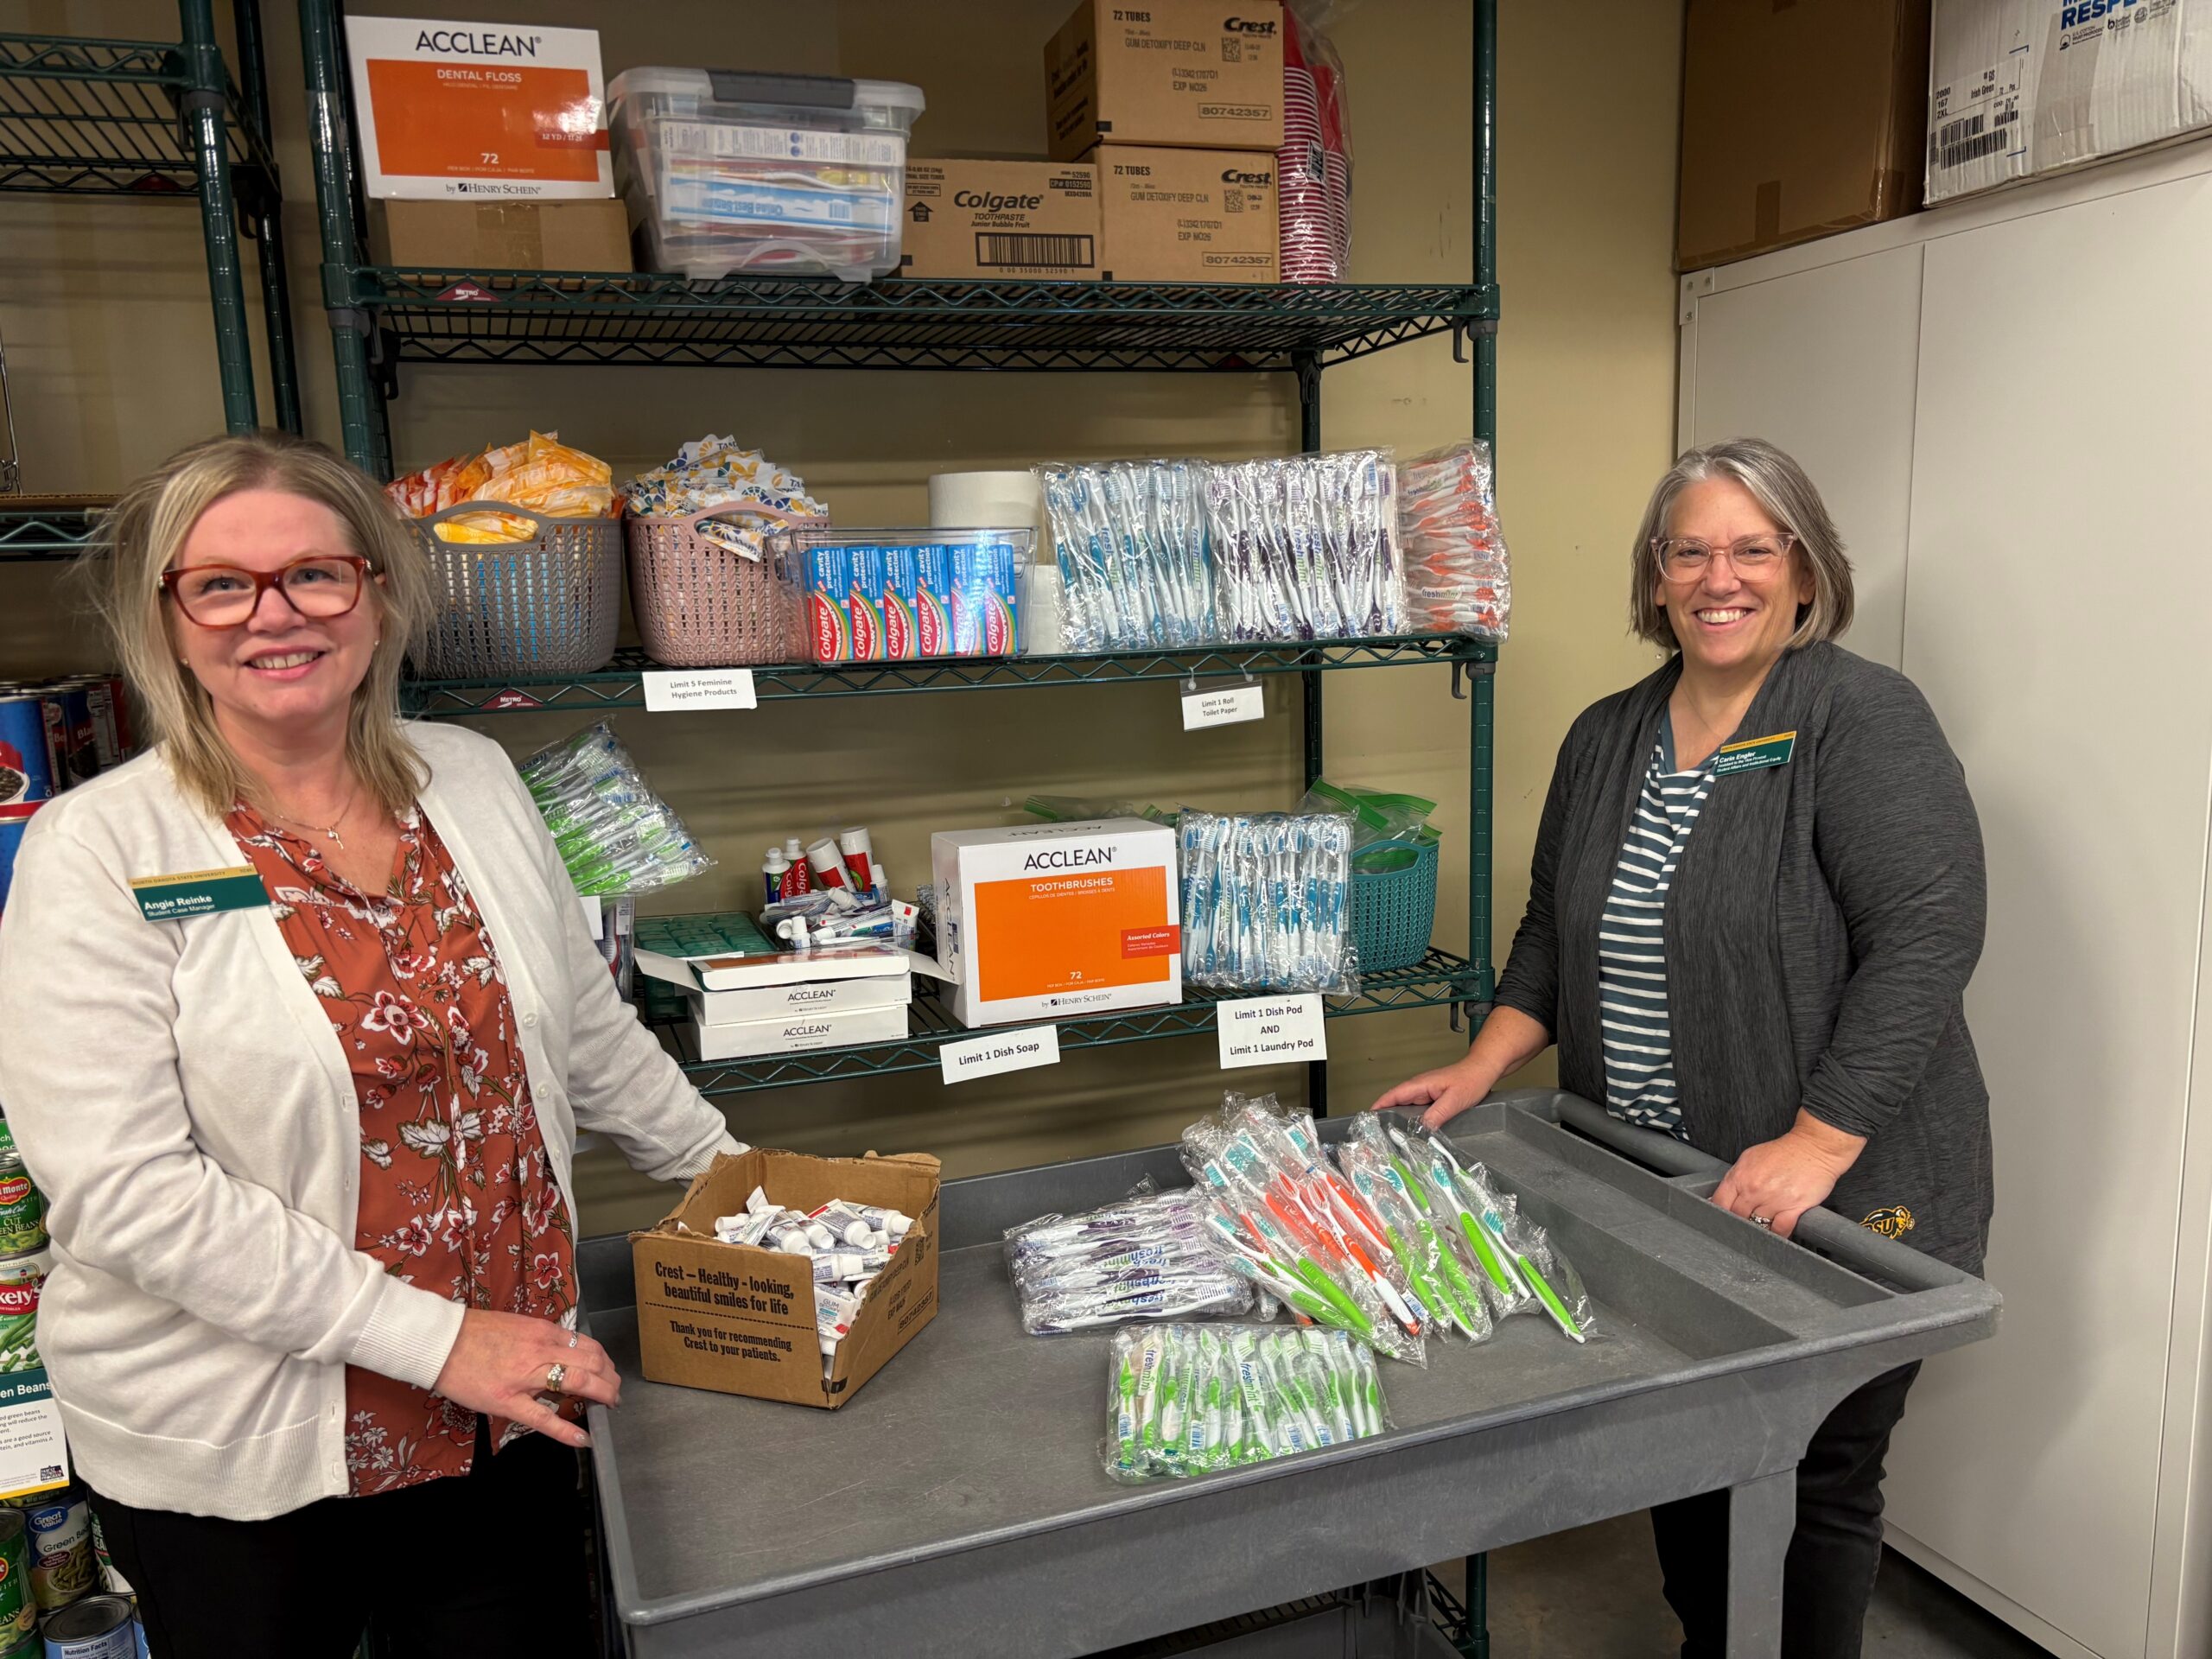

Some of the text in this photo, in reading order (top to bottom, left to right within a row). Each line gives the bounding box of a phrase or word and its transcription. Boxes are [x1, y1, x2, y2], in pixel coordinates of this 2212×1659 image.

[1113, 10, 1151, 22] 72 TUBES
[1224, 17, 1274, 34] Crest
[416, 30, 537, 57] ACCLEAN
[1125, 38, 1140, 48] GUM
[1141, 39, 1173, 49] DETOXIFY
[1174, 41, 1191, 51] DEEP
[437, 69, 522, 83] DENTAL FLOSS
[1173, 81, 1187, 91] EXP
[1982, 84, 1994, 95] Green
[1202, 107, 1269, 118] 80742357
[481, 153, 499, 164] 72
[1114, 165, 1151, 176] 72 TUBES
[1221, 168, 1271, 184] Crest
[446, 184, 455, 194] by
[954, 190, 1040, 213] Colgate
[1130, 192, 1145, 200] GUM
[1147, 192, 1176, 202] DETOXIFY
[1178, 194, 1195, 203] DEEP
[974, 213, 1026, 221] TOOTHPASTE
[1178, 232, 1192, 241] EXP
[1205, 256, 1271, 264] 80742357
[824, 550, 833, 588] protection
[925, 547, 934, 585] protection
[820, 607, 832, 658] Colgate
[855, 607, 867, 658] Colgate
[888, 606, 899, 657] Colgate
[921, 603, 932, 653] Colgate
[989, 603, 1000, 652] Colgate
[1024, 846, 1112, 871] ACCLEAN
[1031, 877, 1113, 893] TOOTHBRUSHES
[144, 895, 213, 911] Angie Reinke
[147, 908, 170, 917] Student
[189, 904, 215, 912] Manager
[1070, 971, 1082, 980] 72
[788, 989, 834, 1001] ACCLEAN
[1058, 997, 1084, 1006] HENRY
[1235, 1010, 1256, 1020] Limit
[1266, 1007, 1284, 1017] Dish
[1287, 1005, 1303, 1014] Pod
[783, 1025, 830, 1037] ACCLEAN
[1261, 1025, 1280, 1034] AND
[1230, 1046, 1251, 1055] Limit
[1261, 1041, 1295, 1052] Laundry
[1297, 1039, 1313, 1048] Pod
[959, 1043, 1039, 1065] Limit 1 Dish Soap
[3, 1183, 28, 1194] Monte
[3, 1217, 21, 1226] CUT
[16, 1219, 40, 1231] BEANS
[655, 1262, 794, 1300] Crest Healthy looking,
[664, 1282, 789, 1315] beautiful smiles for life
[670, 1320, 792, 1352] Thank you for recommending
[684, 1337, 781, 1362] Crest to your patients.
[17, 1382, 51, 1395] Beans
[18, 1433, 32, 1442] good
[25, 1438, 48, 1446] vitamins
[35, 1511, 61, 1524] Great
[41, 1518, 63, 1529] Value
[44, 1536, 75, 1553] Green
[0, 1608, 20, 1624] EANS
[65, 1642, 107, 1656] Nutrition Facts
